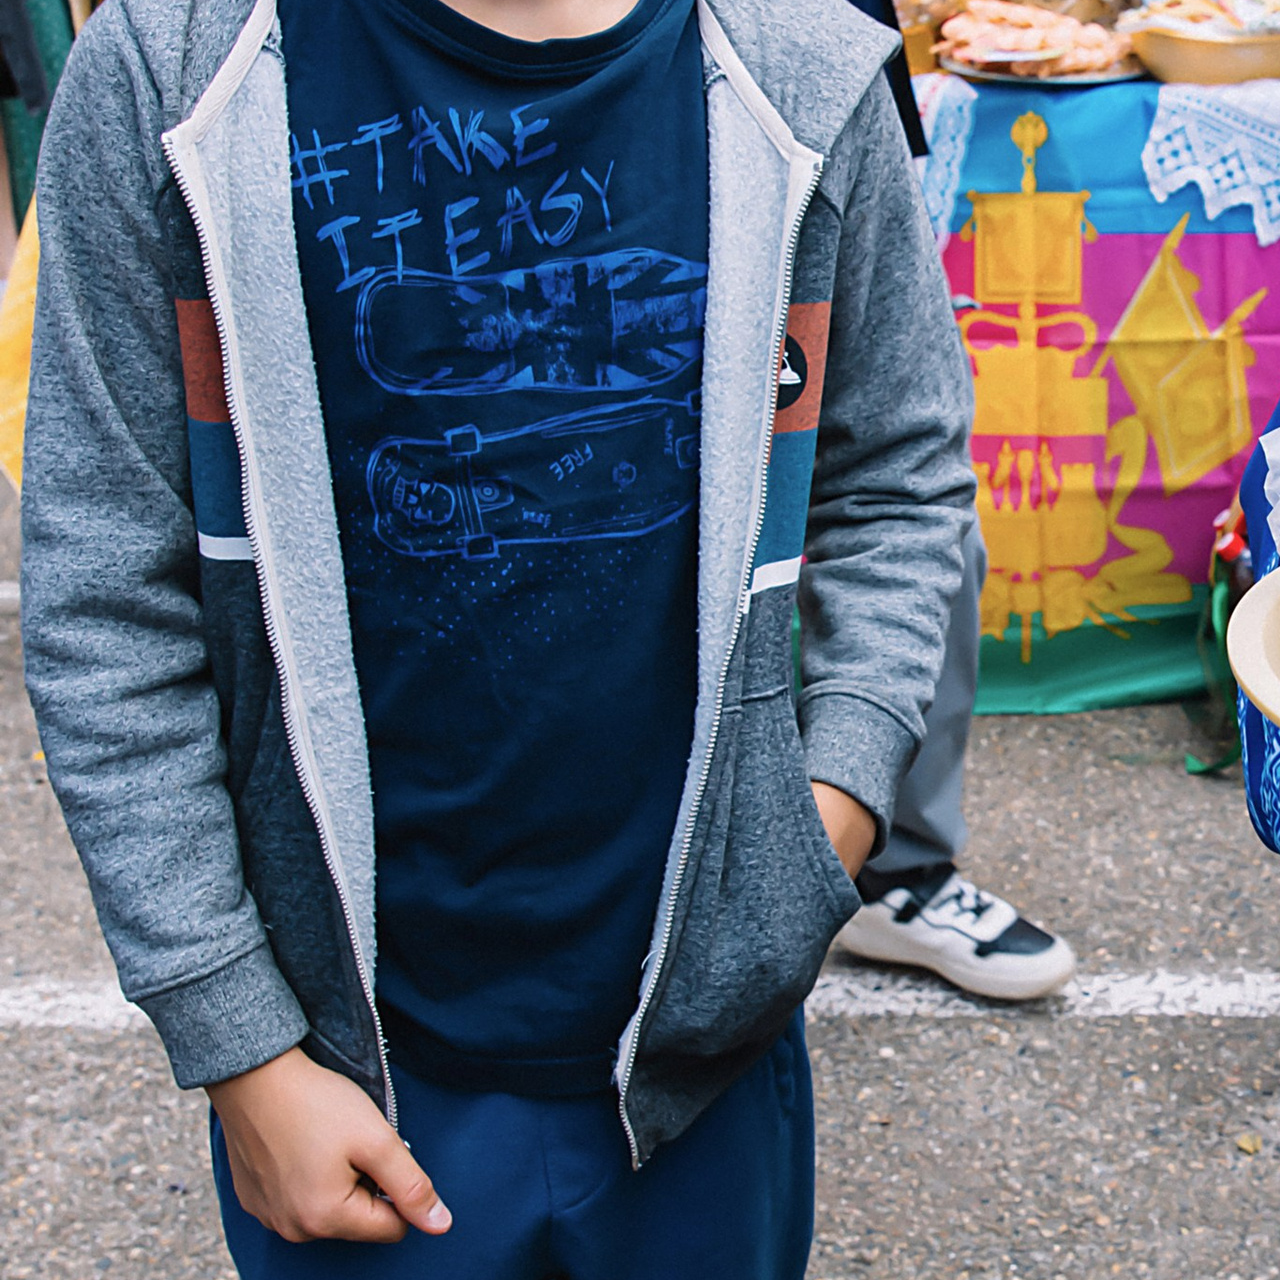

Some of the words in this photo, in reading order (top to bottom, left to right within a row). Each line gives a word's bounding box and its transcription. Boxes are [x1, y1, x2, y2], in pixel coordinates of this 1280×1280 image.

[316, 208, 423, 293] IT
[444, 159, 615, 277] EASY
[548, 441, 594, 482] FREE
